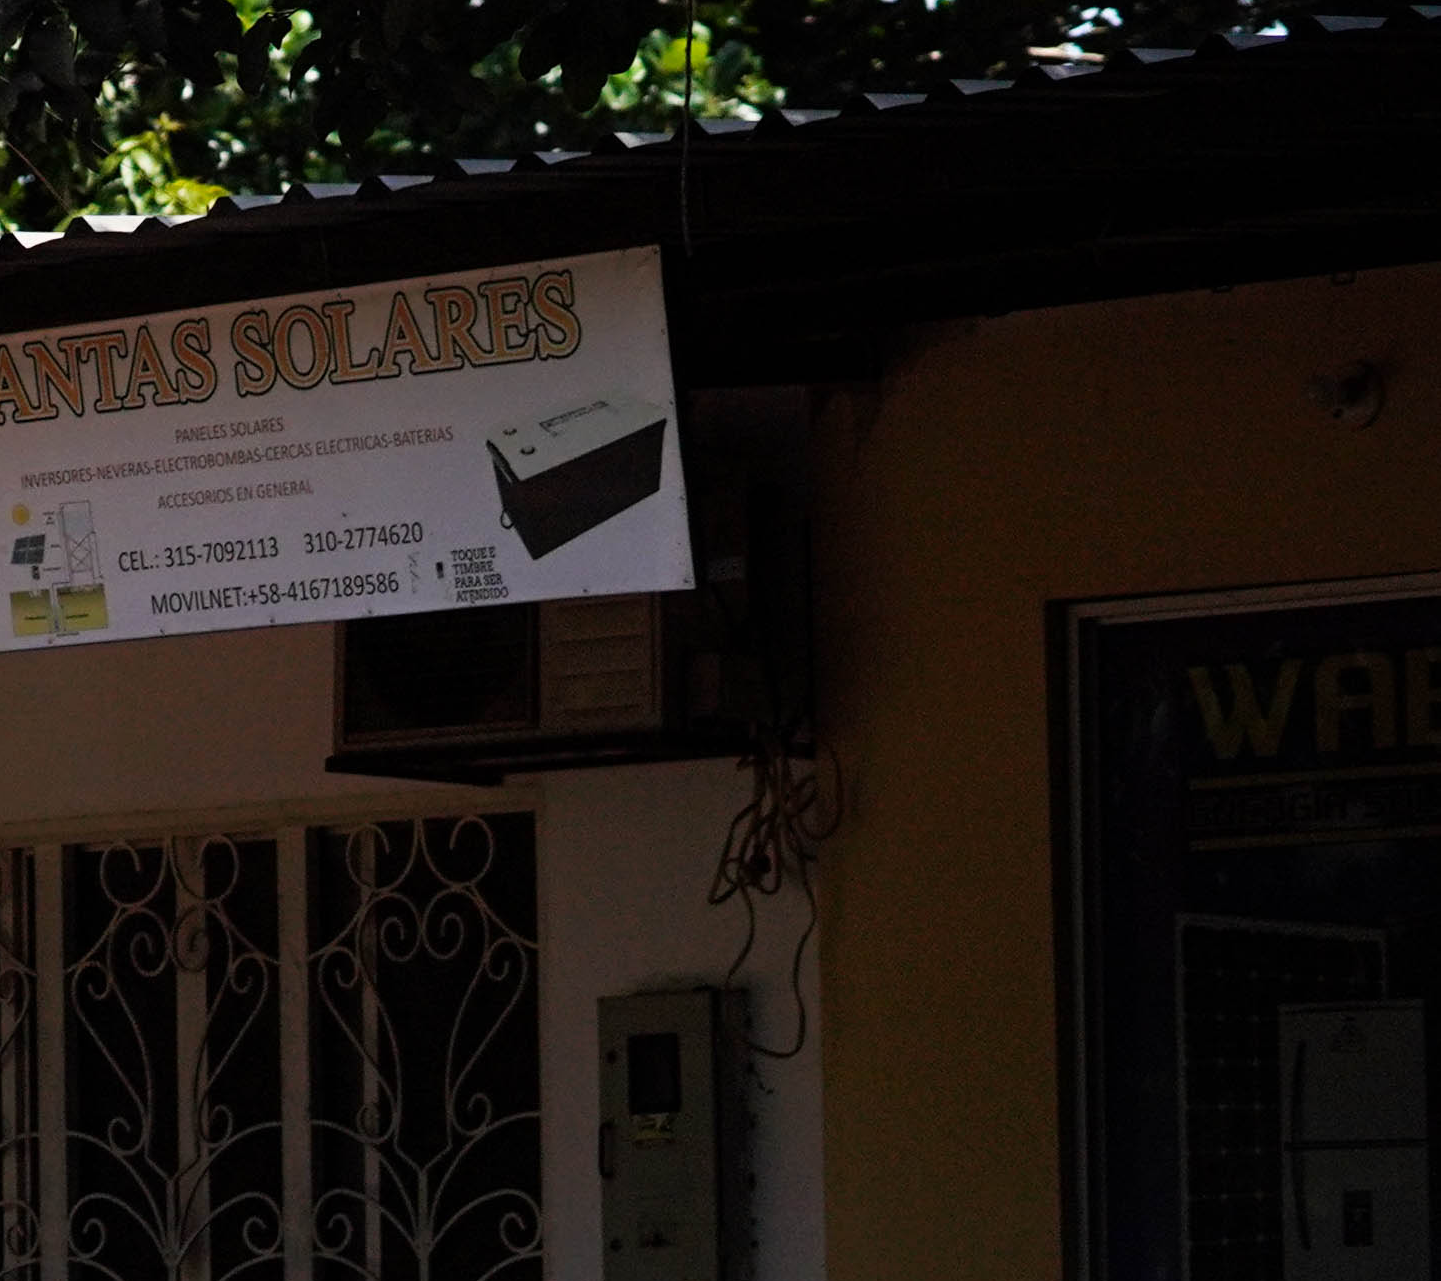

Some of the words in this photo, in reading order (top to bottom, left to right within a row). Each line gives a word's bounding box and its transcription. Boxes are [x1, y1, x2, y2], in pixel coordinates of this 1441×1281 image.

[231, 269, 581, 396] SOLARES
[175, 424, 228, 443] PANELES
[230, 417, 284, 437] SOLARES
[157, 488, 234, 509] ACCESORIOS
[237, 485, 253, 502] EN
[257, 479, 314, 499] GENERAL
[165, 536, 279, 568] 315-7092113
[304, 521, 423, 554] 310-2774620
[451, 548, 487, 561] TOQUE
[452, 560, 493, 575] TIMBRE
[455, 576, 482, 588] PARA
[483, 574, 503, 585] SER
